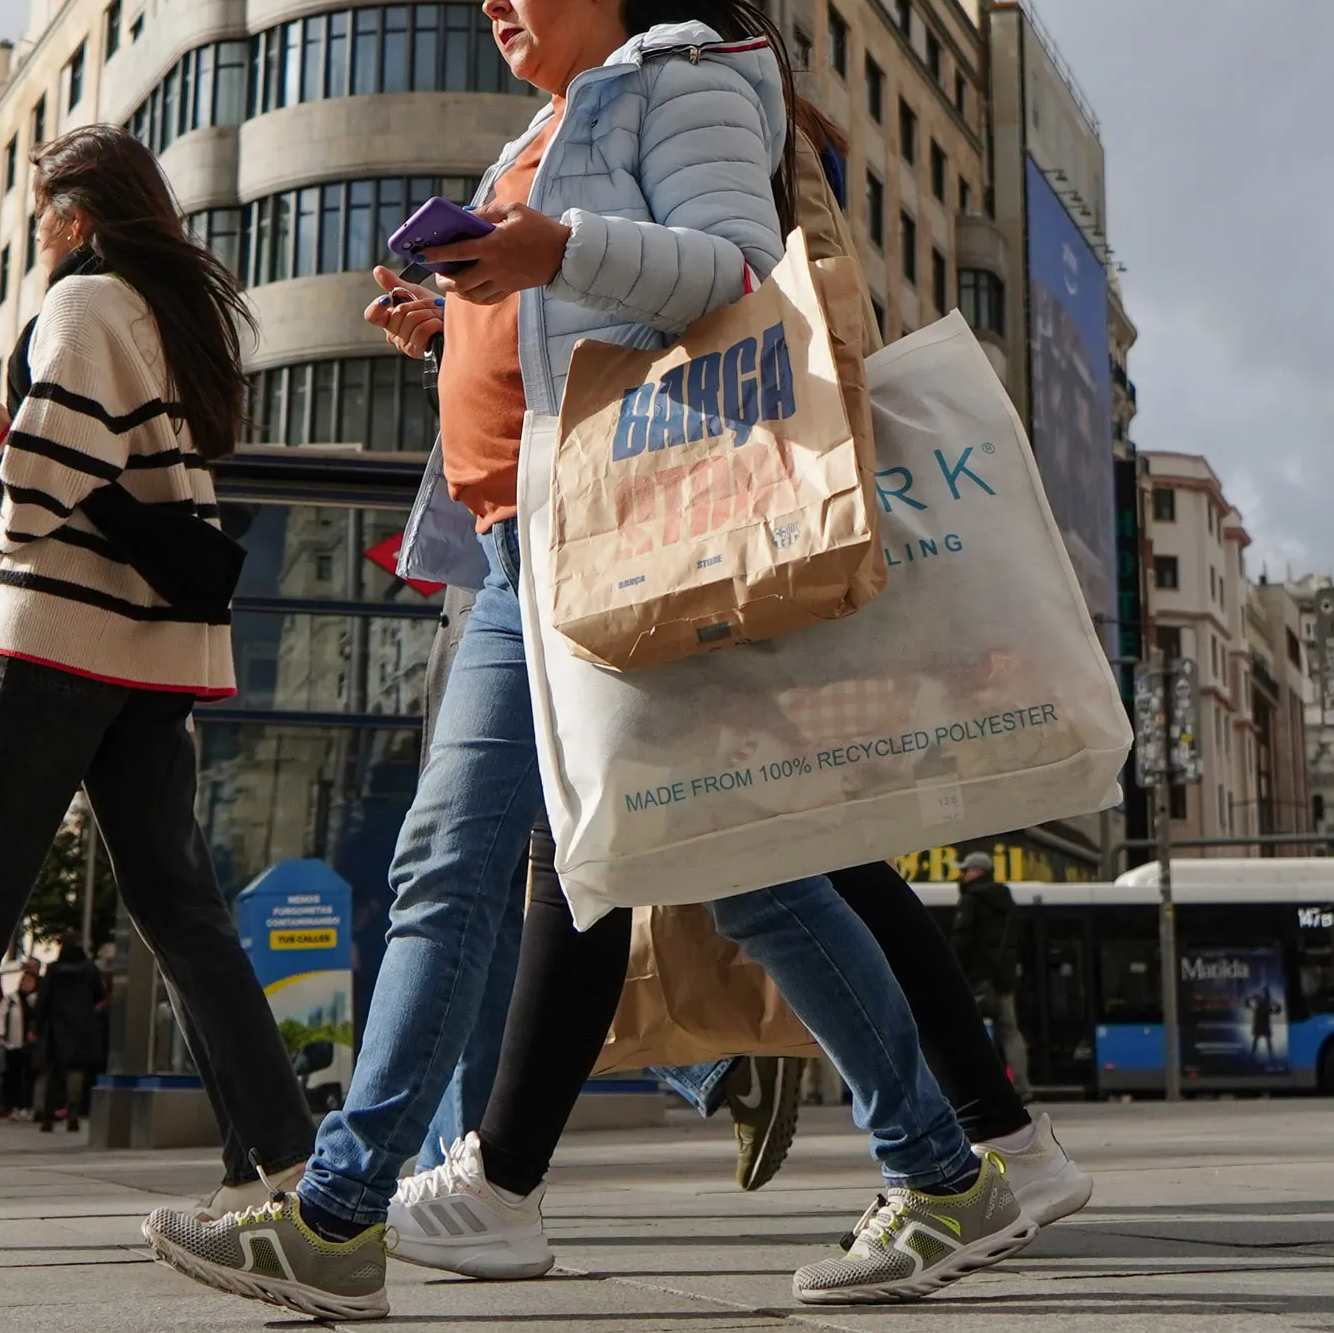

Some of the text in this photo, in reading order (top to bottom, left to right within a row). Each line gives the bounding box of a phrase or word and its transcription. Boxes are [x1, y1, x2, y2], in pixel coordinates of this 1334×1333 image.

[612, 322, 796, 462] BARÇA
[625, 703, 1058, 813] MADE FROM 100% RECYCLED POLYESTER
[1181, 957, 1250, 980] Matilda
